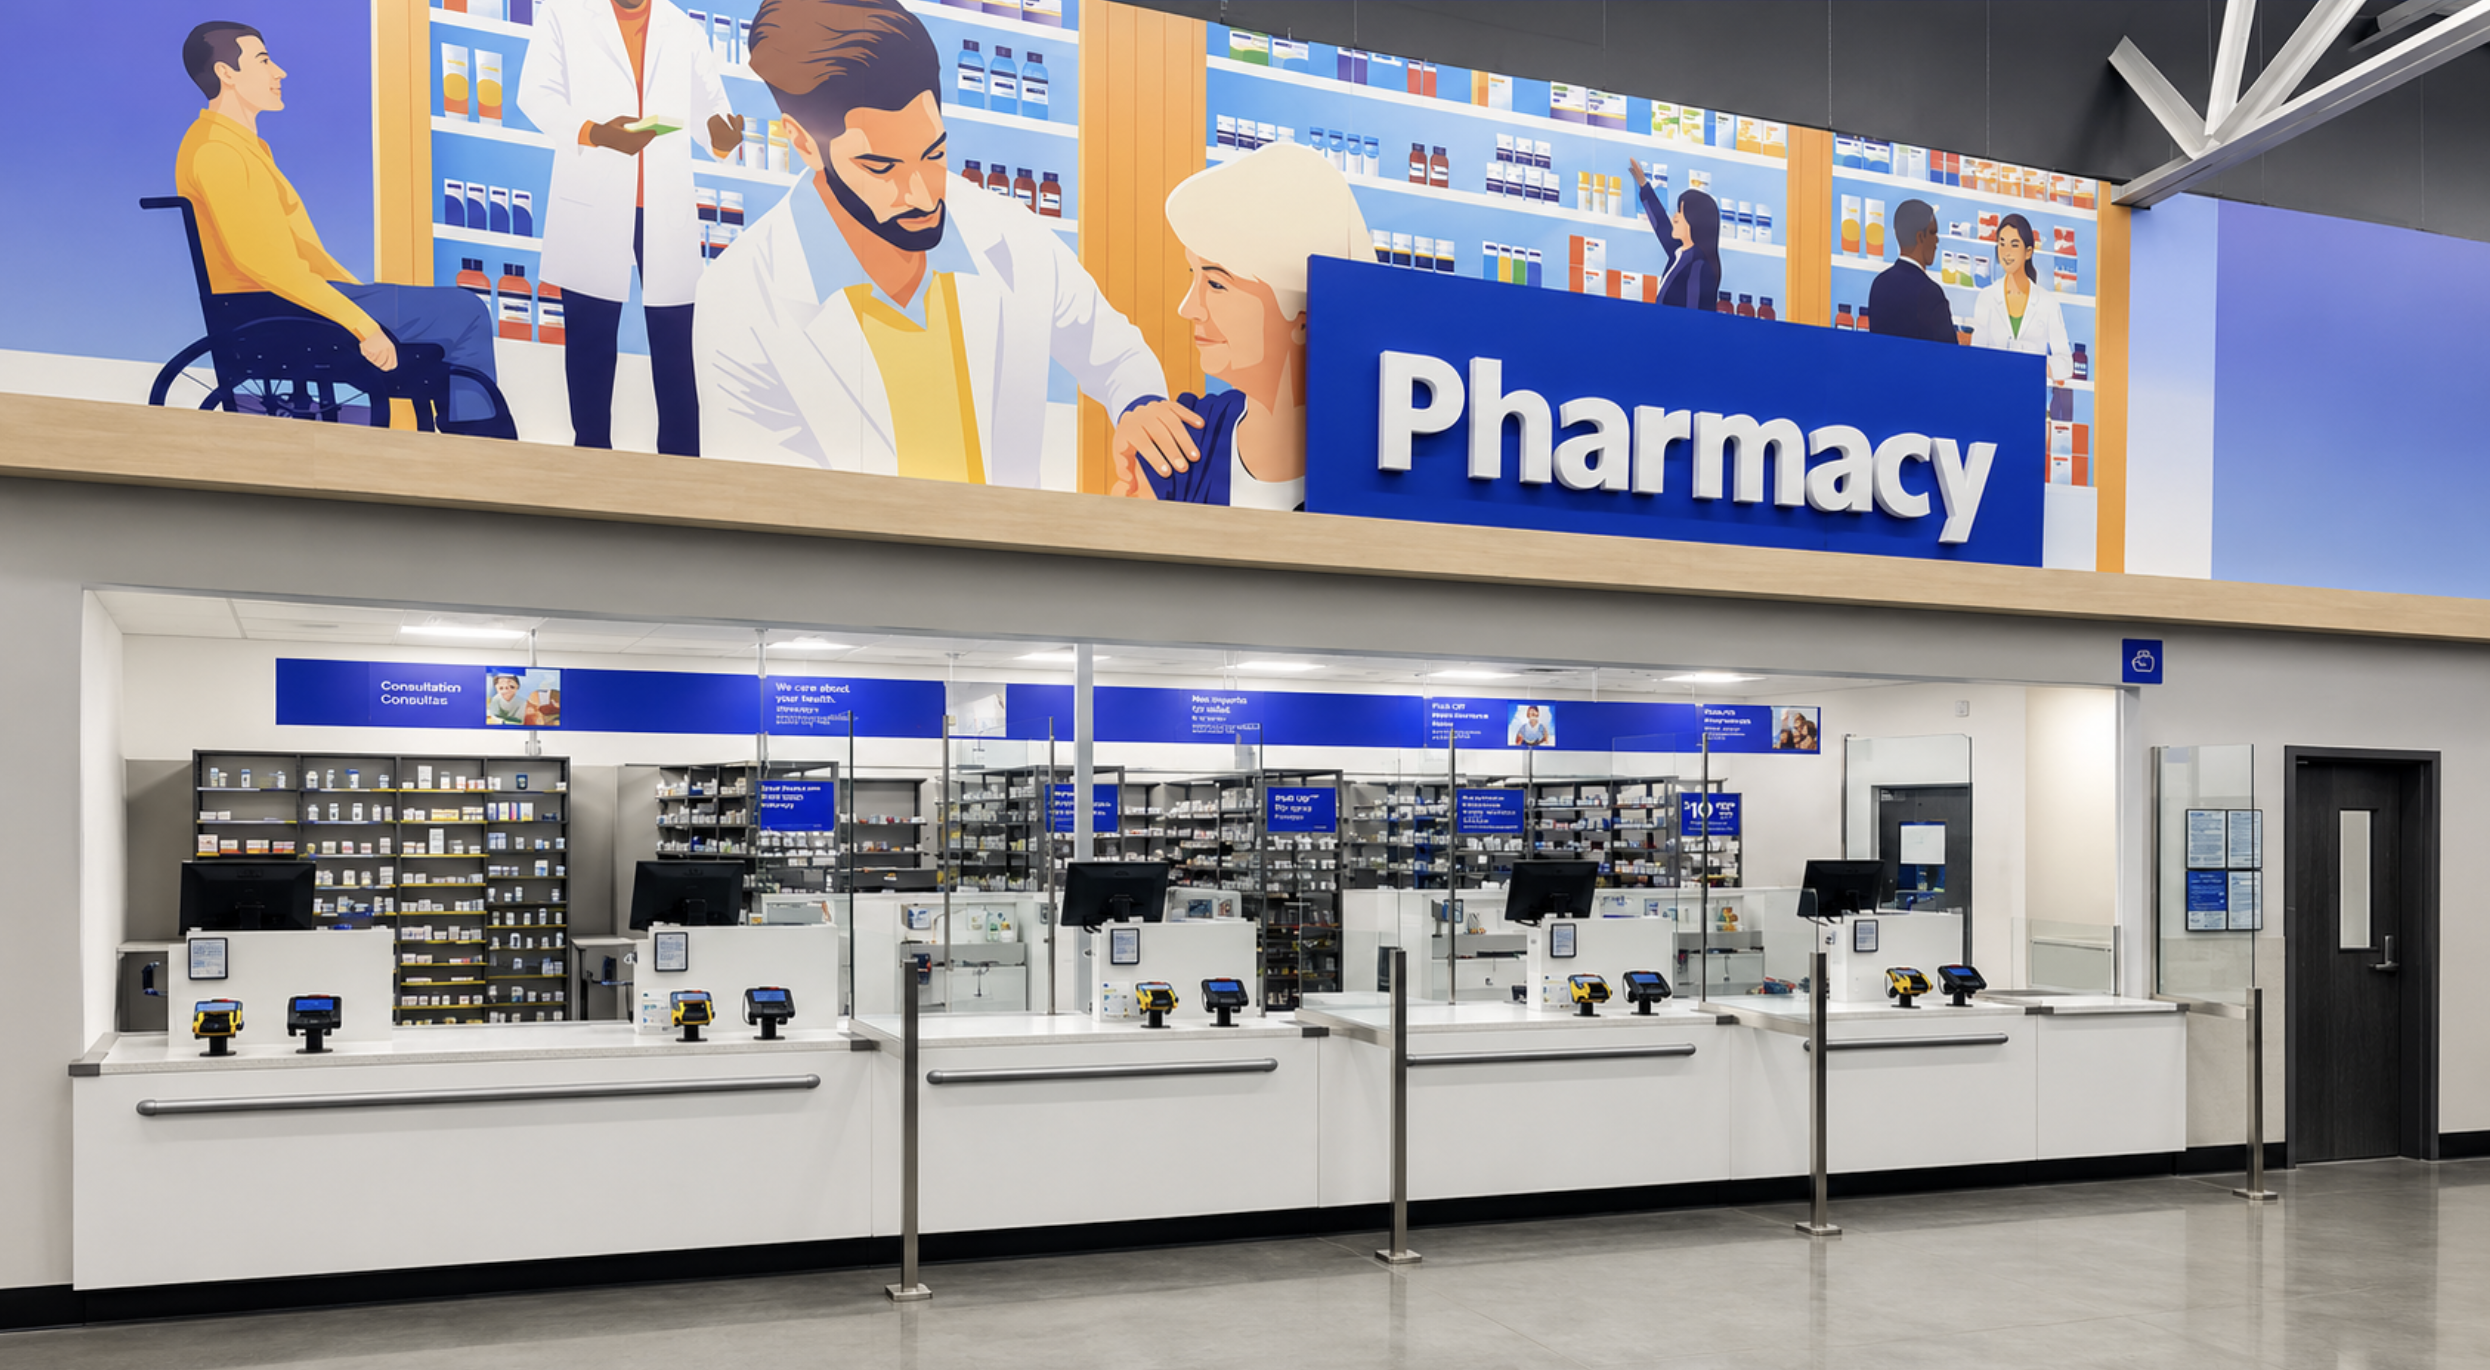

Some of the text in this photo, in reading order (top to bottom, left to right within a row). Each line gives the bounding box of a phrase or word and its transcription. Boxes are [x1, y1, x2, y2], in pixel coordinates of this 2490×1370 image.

[1378, 350, 1997, 544] Pharmacy
[381, 680, 462, 693] Consultation
[775, 682, 792, 692] We
